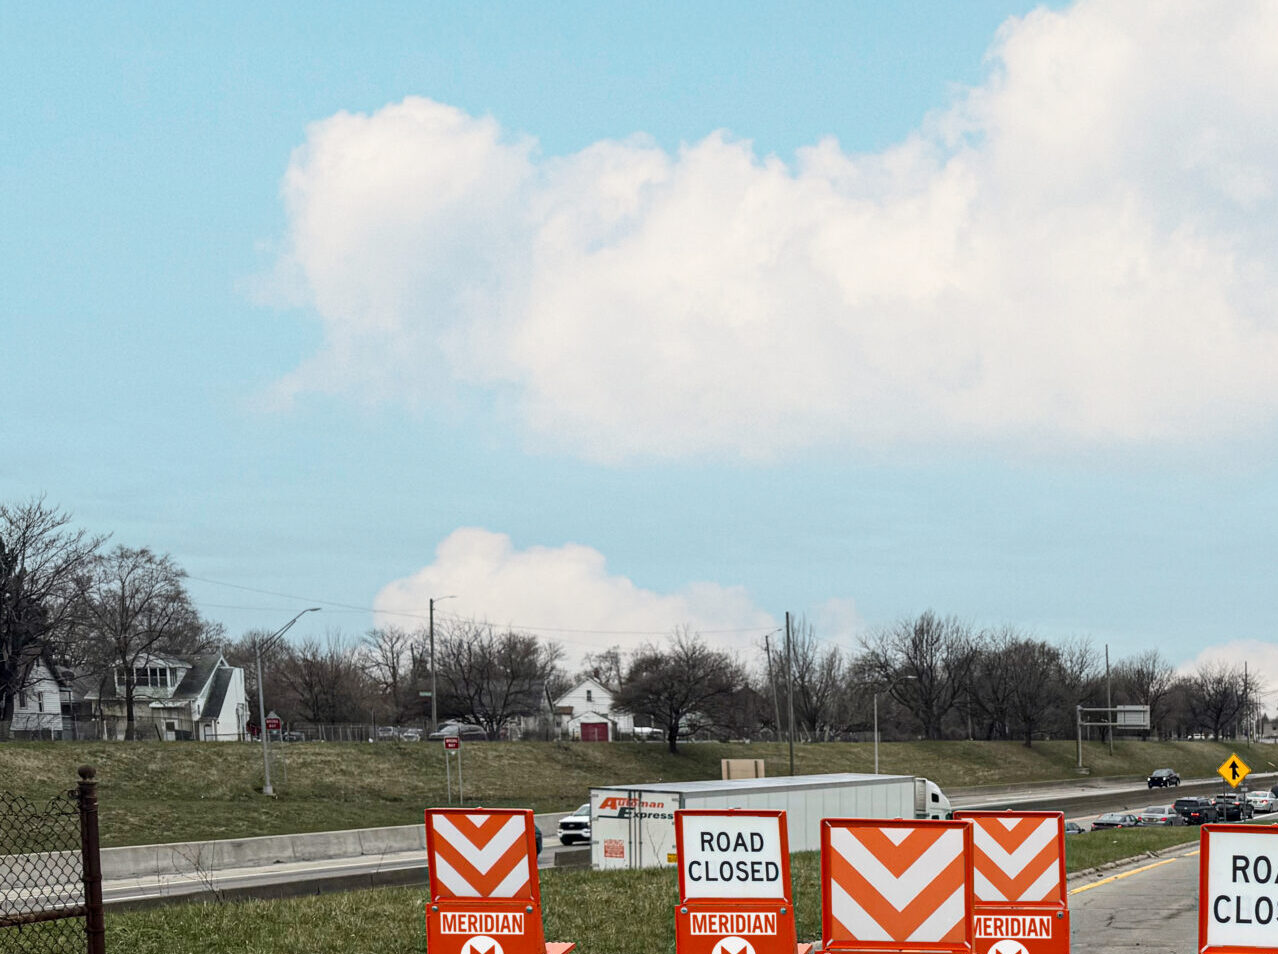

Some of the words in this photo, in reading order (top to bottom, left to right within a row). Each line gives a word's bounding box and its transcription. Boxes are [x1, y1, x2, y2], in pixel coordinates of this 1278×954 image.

[599, 797, 665, 811] Automan
[617, 807, 674, 820] Express
[700, 831, 764, 853] ROAD
[688, 860, 779, 882] CLOSED
[442, 914, 523, 933] MERIDIAN
[692, 914, 775, 933] MERIDIAN
